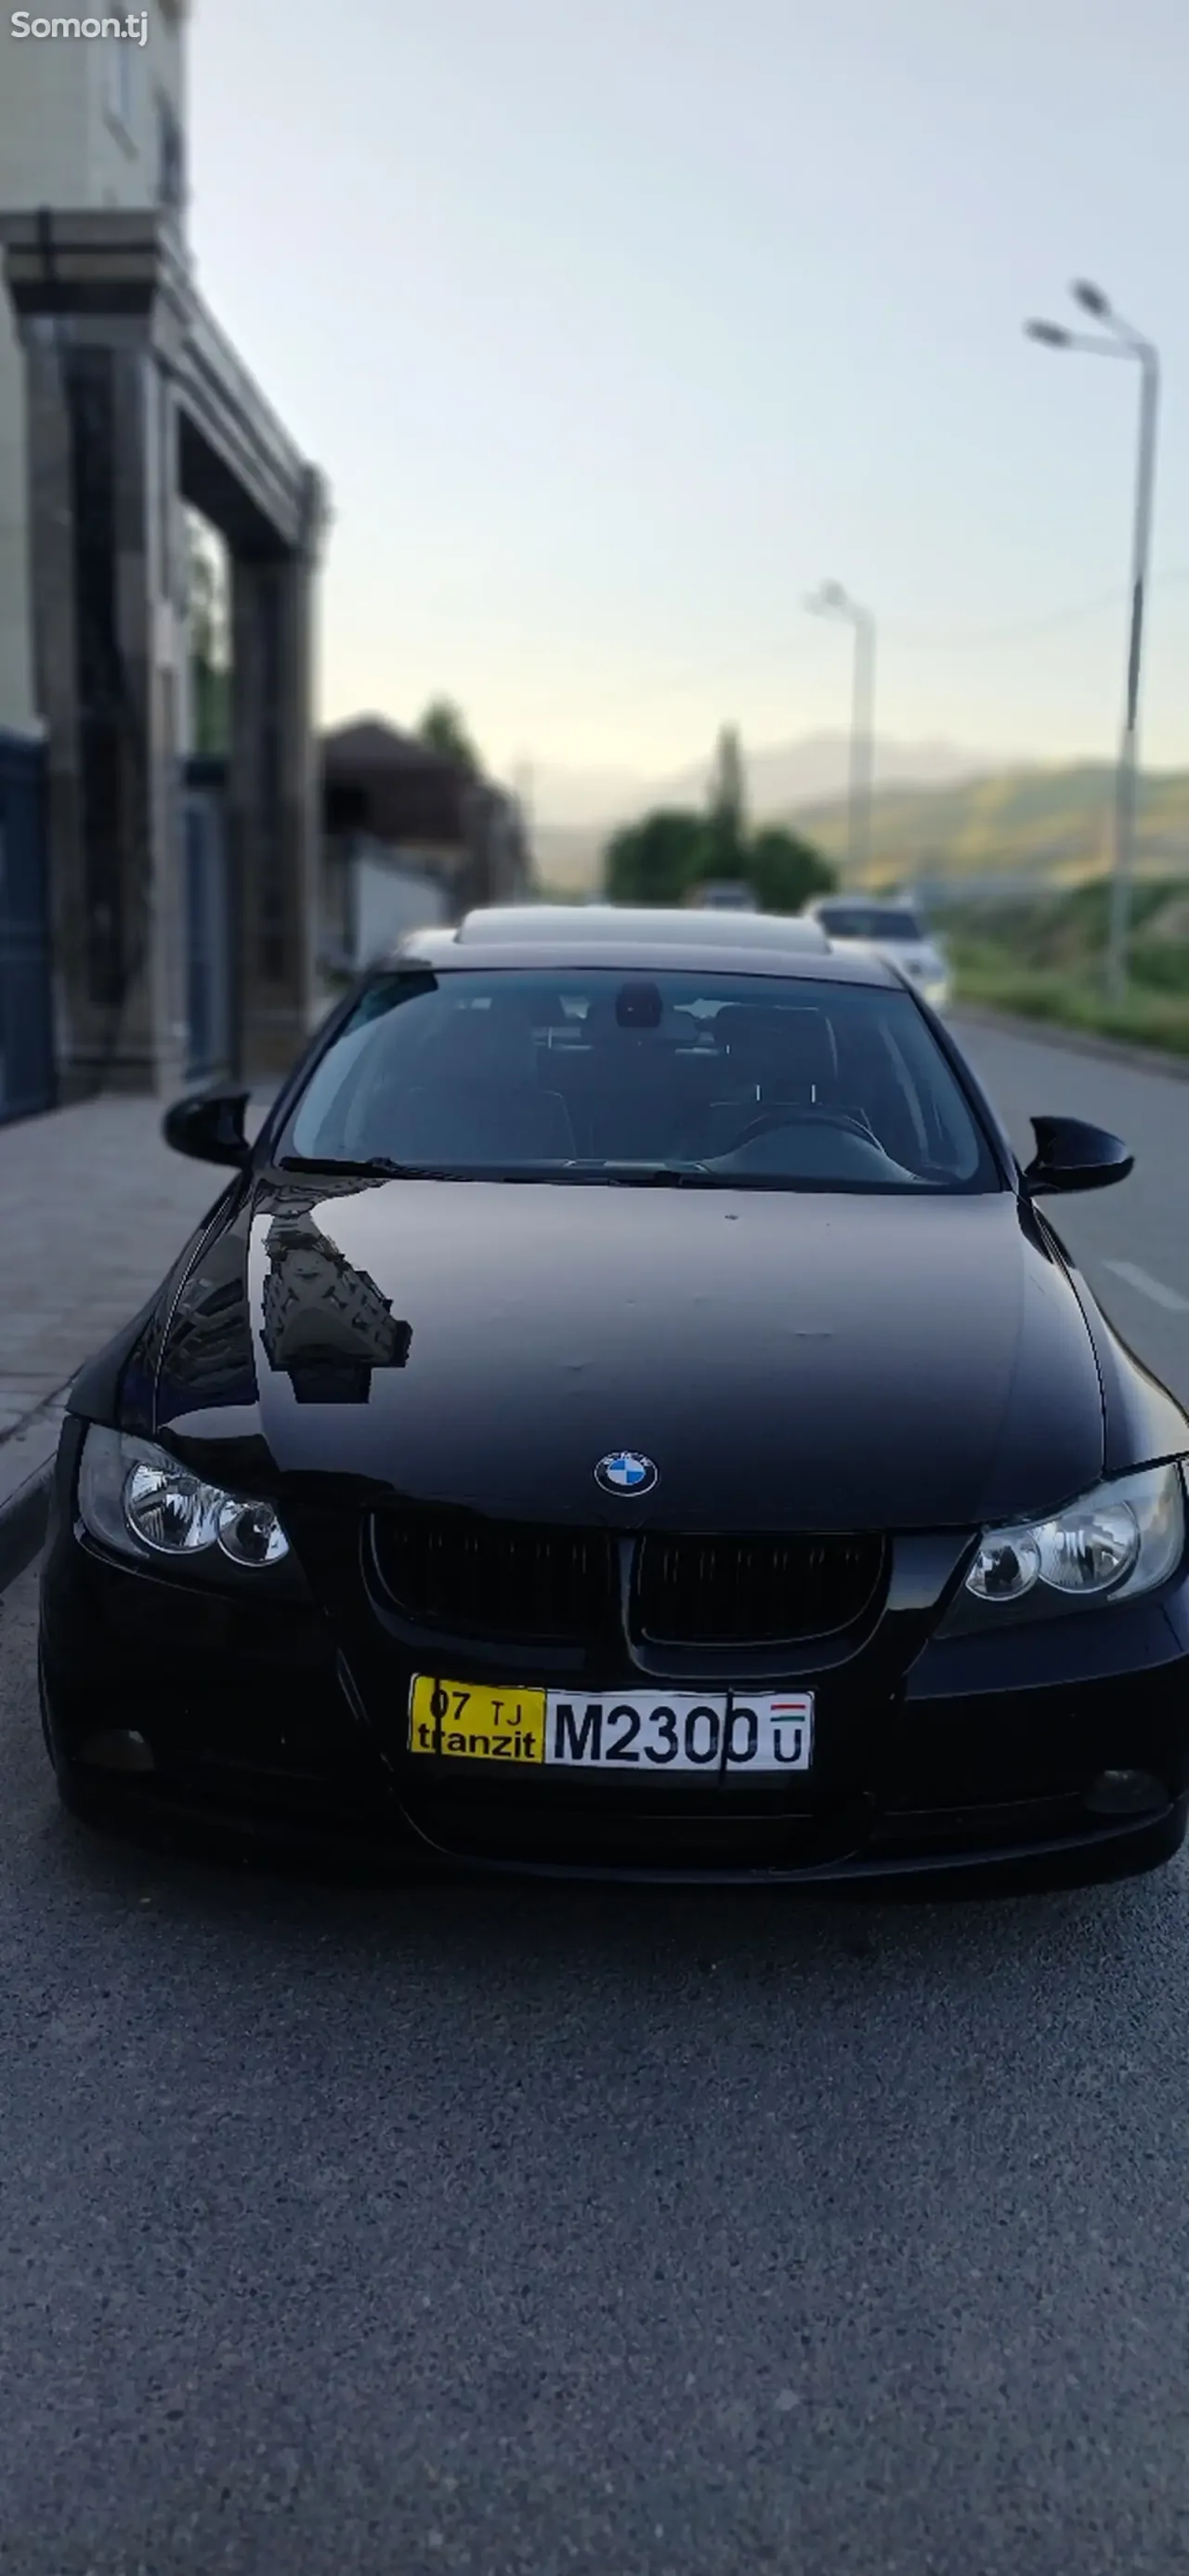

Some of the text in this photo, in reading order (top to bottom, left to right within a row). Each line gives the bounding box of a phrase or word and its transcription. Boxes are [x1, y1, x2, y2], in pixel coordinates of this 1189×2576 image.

[491, 1701, 522, 1726] TJ
[418, 1723, 536, 1758] tranzit
[555, 1703, 758, 1764] M2300
[774, 1728, 802, 1763] U
